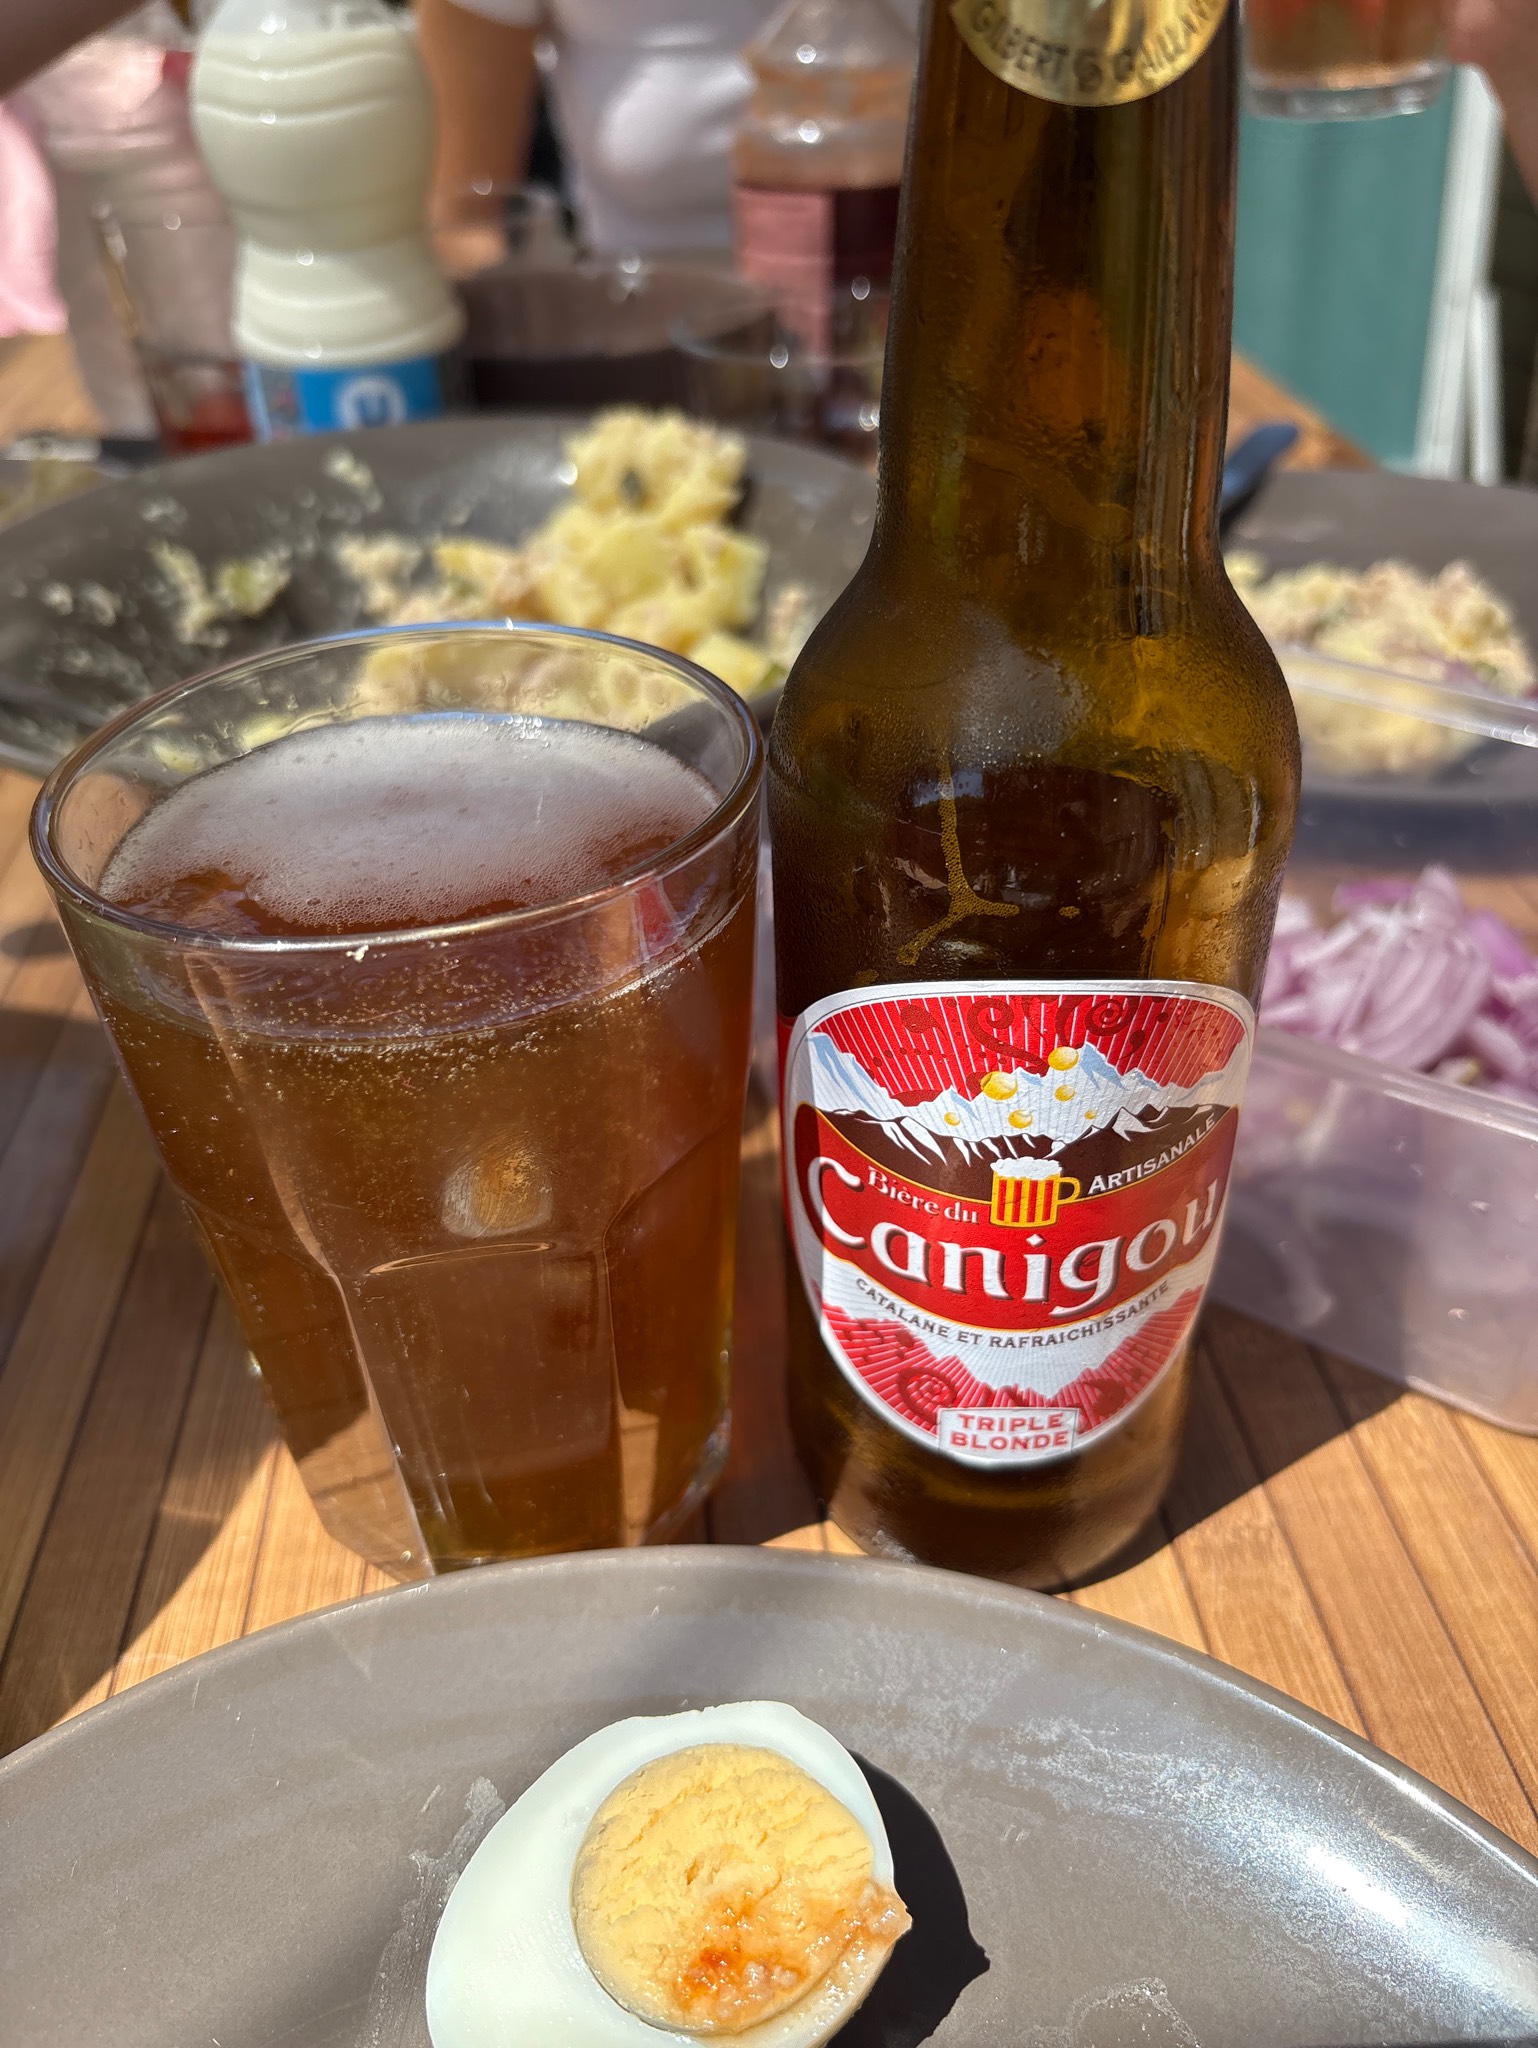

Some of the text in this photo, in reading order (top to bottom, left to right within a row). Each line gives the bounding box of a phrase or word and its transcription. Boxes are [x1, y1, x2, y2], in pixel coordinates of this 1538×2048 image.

[1087, 1112, 1215, 1195] ARTISANALE
[867, 1165, 979, 1224] Bière du
[807, 1156, 1218, 1319] Canigou
[855, 1277, 1169, 1349] CATALANE ET RAFRAICHISSANTE
[949, 1430, 1069, 1451] BLONDE
[957, 1412, 1063, 1432] TRIPLE
